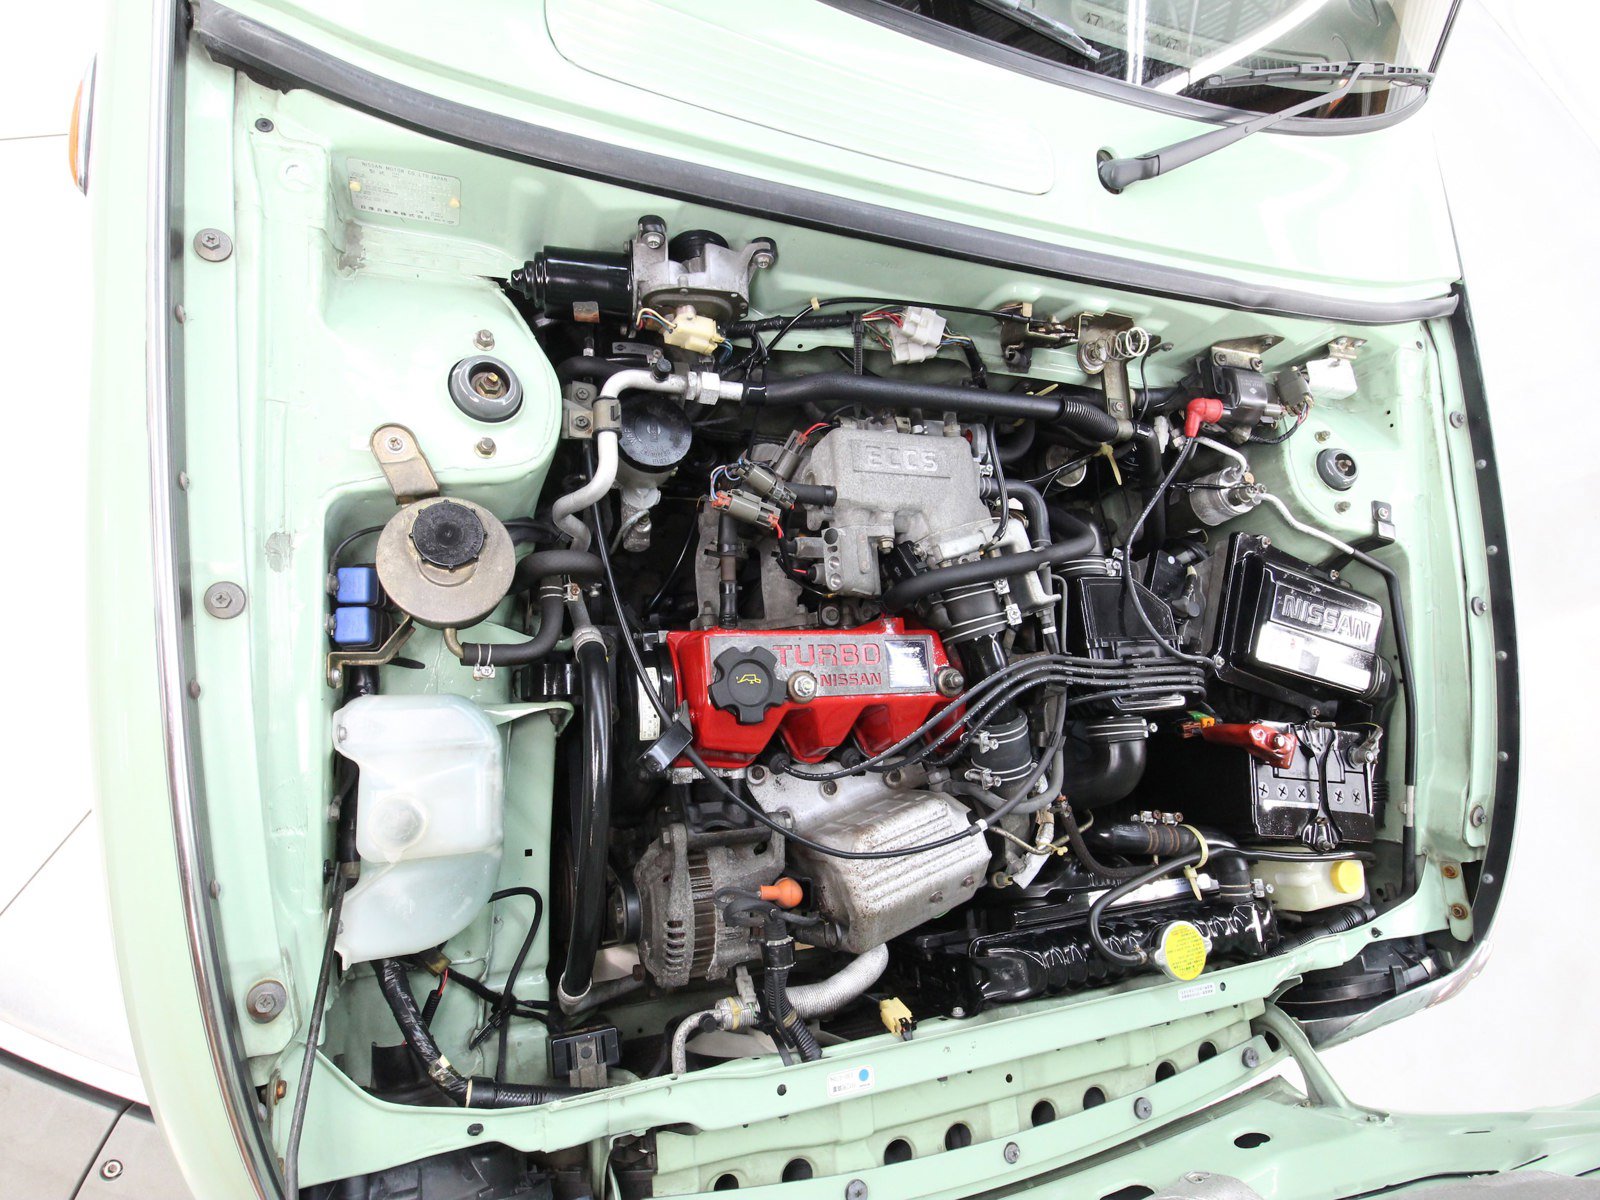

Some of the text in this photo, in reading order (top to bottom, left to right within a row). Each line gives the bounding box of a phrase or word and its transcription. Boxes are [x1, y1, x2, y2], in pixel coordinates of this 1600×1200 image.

[361, 162, 383, 170] NISSAN
[385, 166, 405, 174] MOTOR
[865, 445, 939, 472] ECCS
[1282, 594, 1371, 642] NISSAN
[773, 643, 880, 667] TURBO
[820, 672, 882, 687] NISSAN
